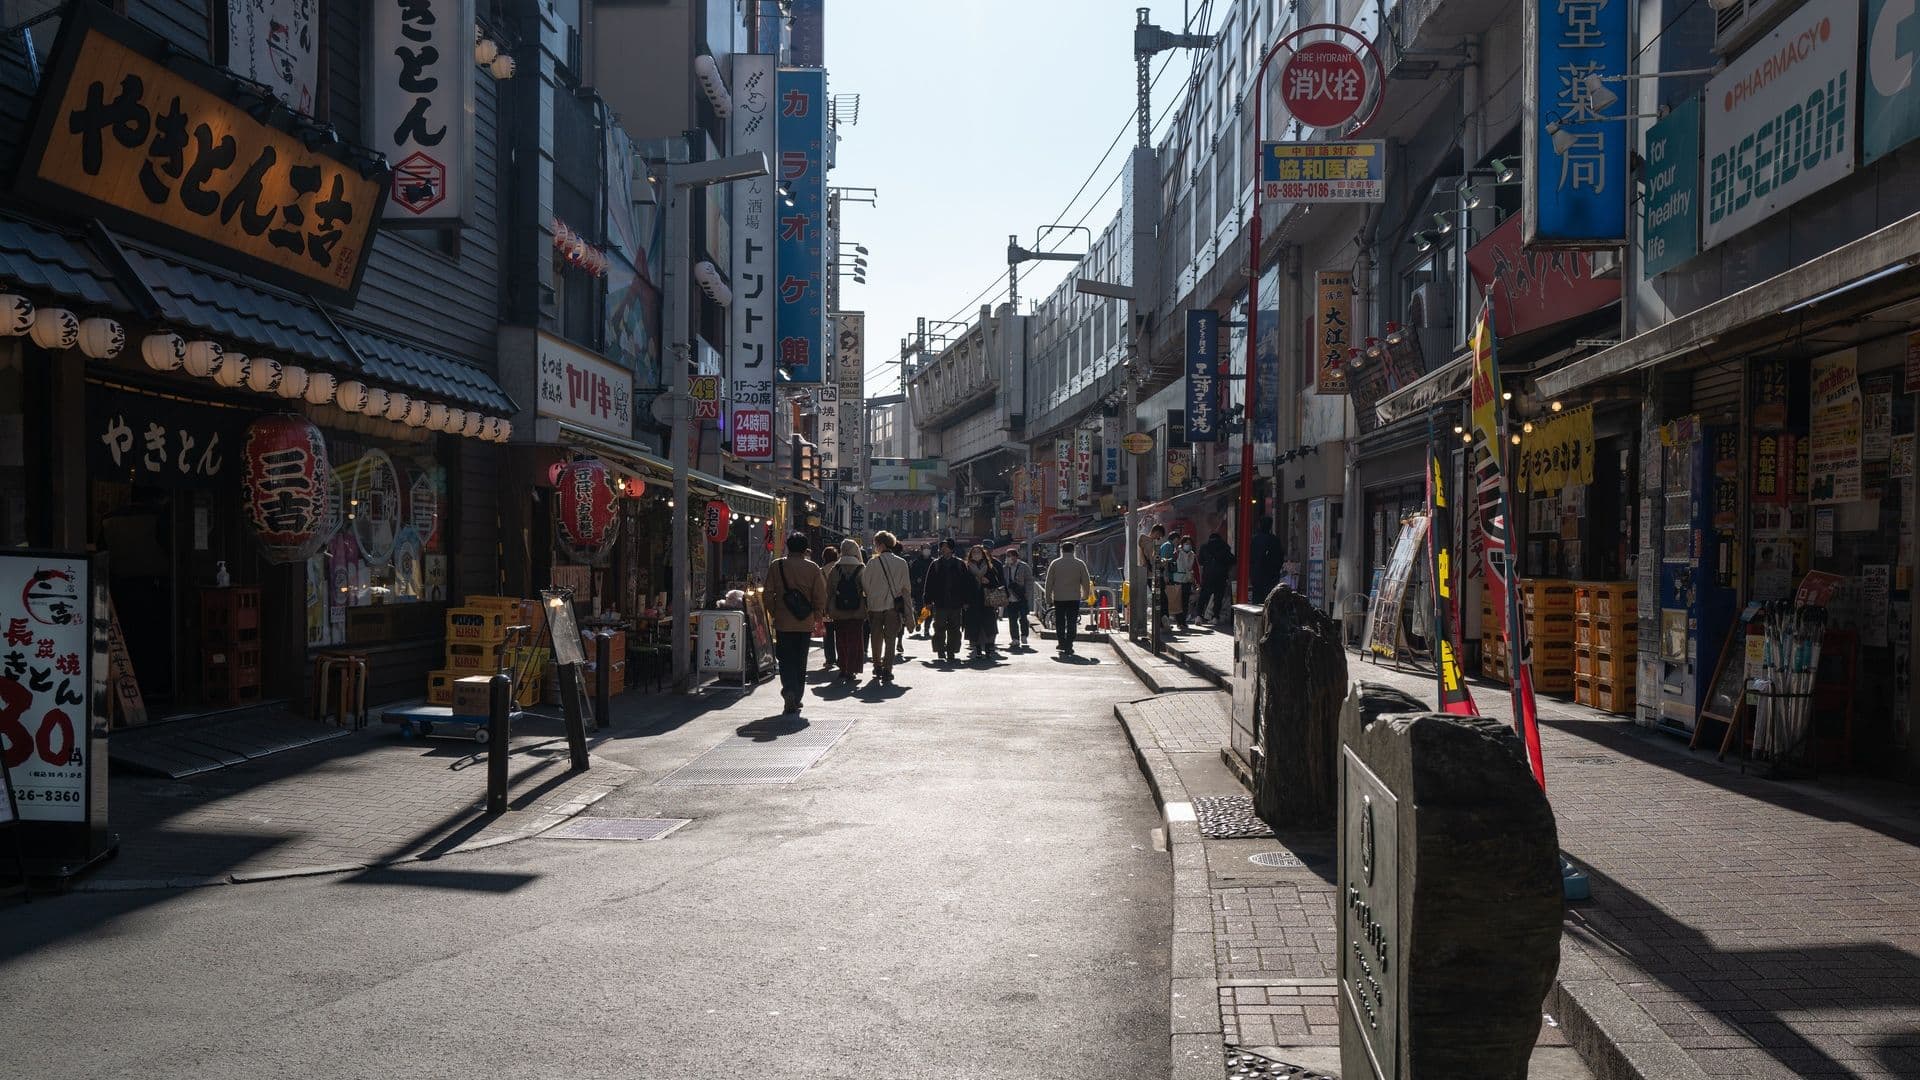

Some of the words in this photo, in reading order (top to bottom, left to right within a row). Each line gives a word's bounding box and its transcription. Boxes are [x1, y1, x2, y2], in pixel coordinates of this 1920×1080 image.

[1296, 52, 1314, 63] FIRE
[1316, 52, 1353, 63] HYDRANT
[1733, 21, 1820, 108] PHARMACY
[1289, 68, 1359, 101] 消火栓
[1650, 135, 1667, 166] for
[1710, 70, 1847, 224] BISEIDOH
[1279, 158, 1368, 180] 協和医院
[1648, 163, 1677, 197] your
[1648, 189, 1691, 228] healthy
[781, 89, 809, 363] カラオケ館
[1647, 238, 1664, 262] life
[742, 238, 763, 368] トントン
[735, 392, 771, 405] 220席
[736, 413, 769, 432] 24時間
[101, 415, 223, 476] やきとん
[736, 435, 769, 453] 営業中
[822, 469, 837, 478] 2F
[258, 449, 312, 532] 三吉
[455, 656, 480, 667] KIRIN
